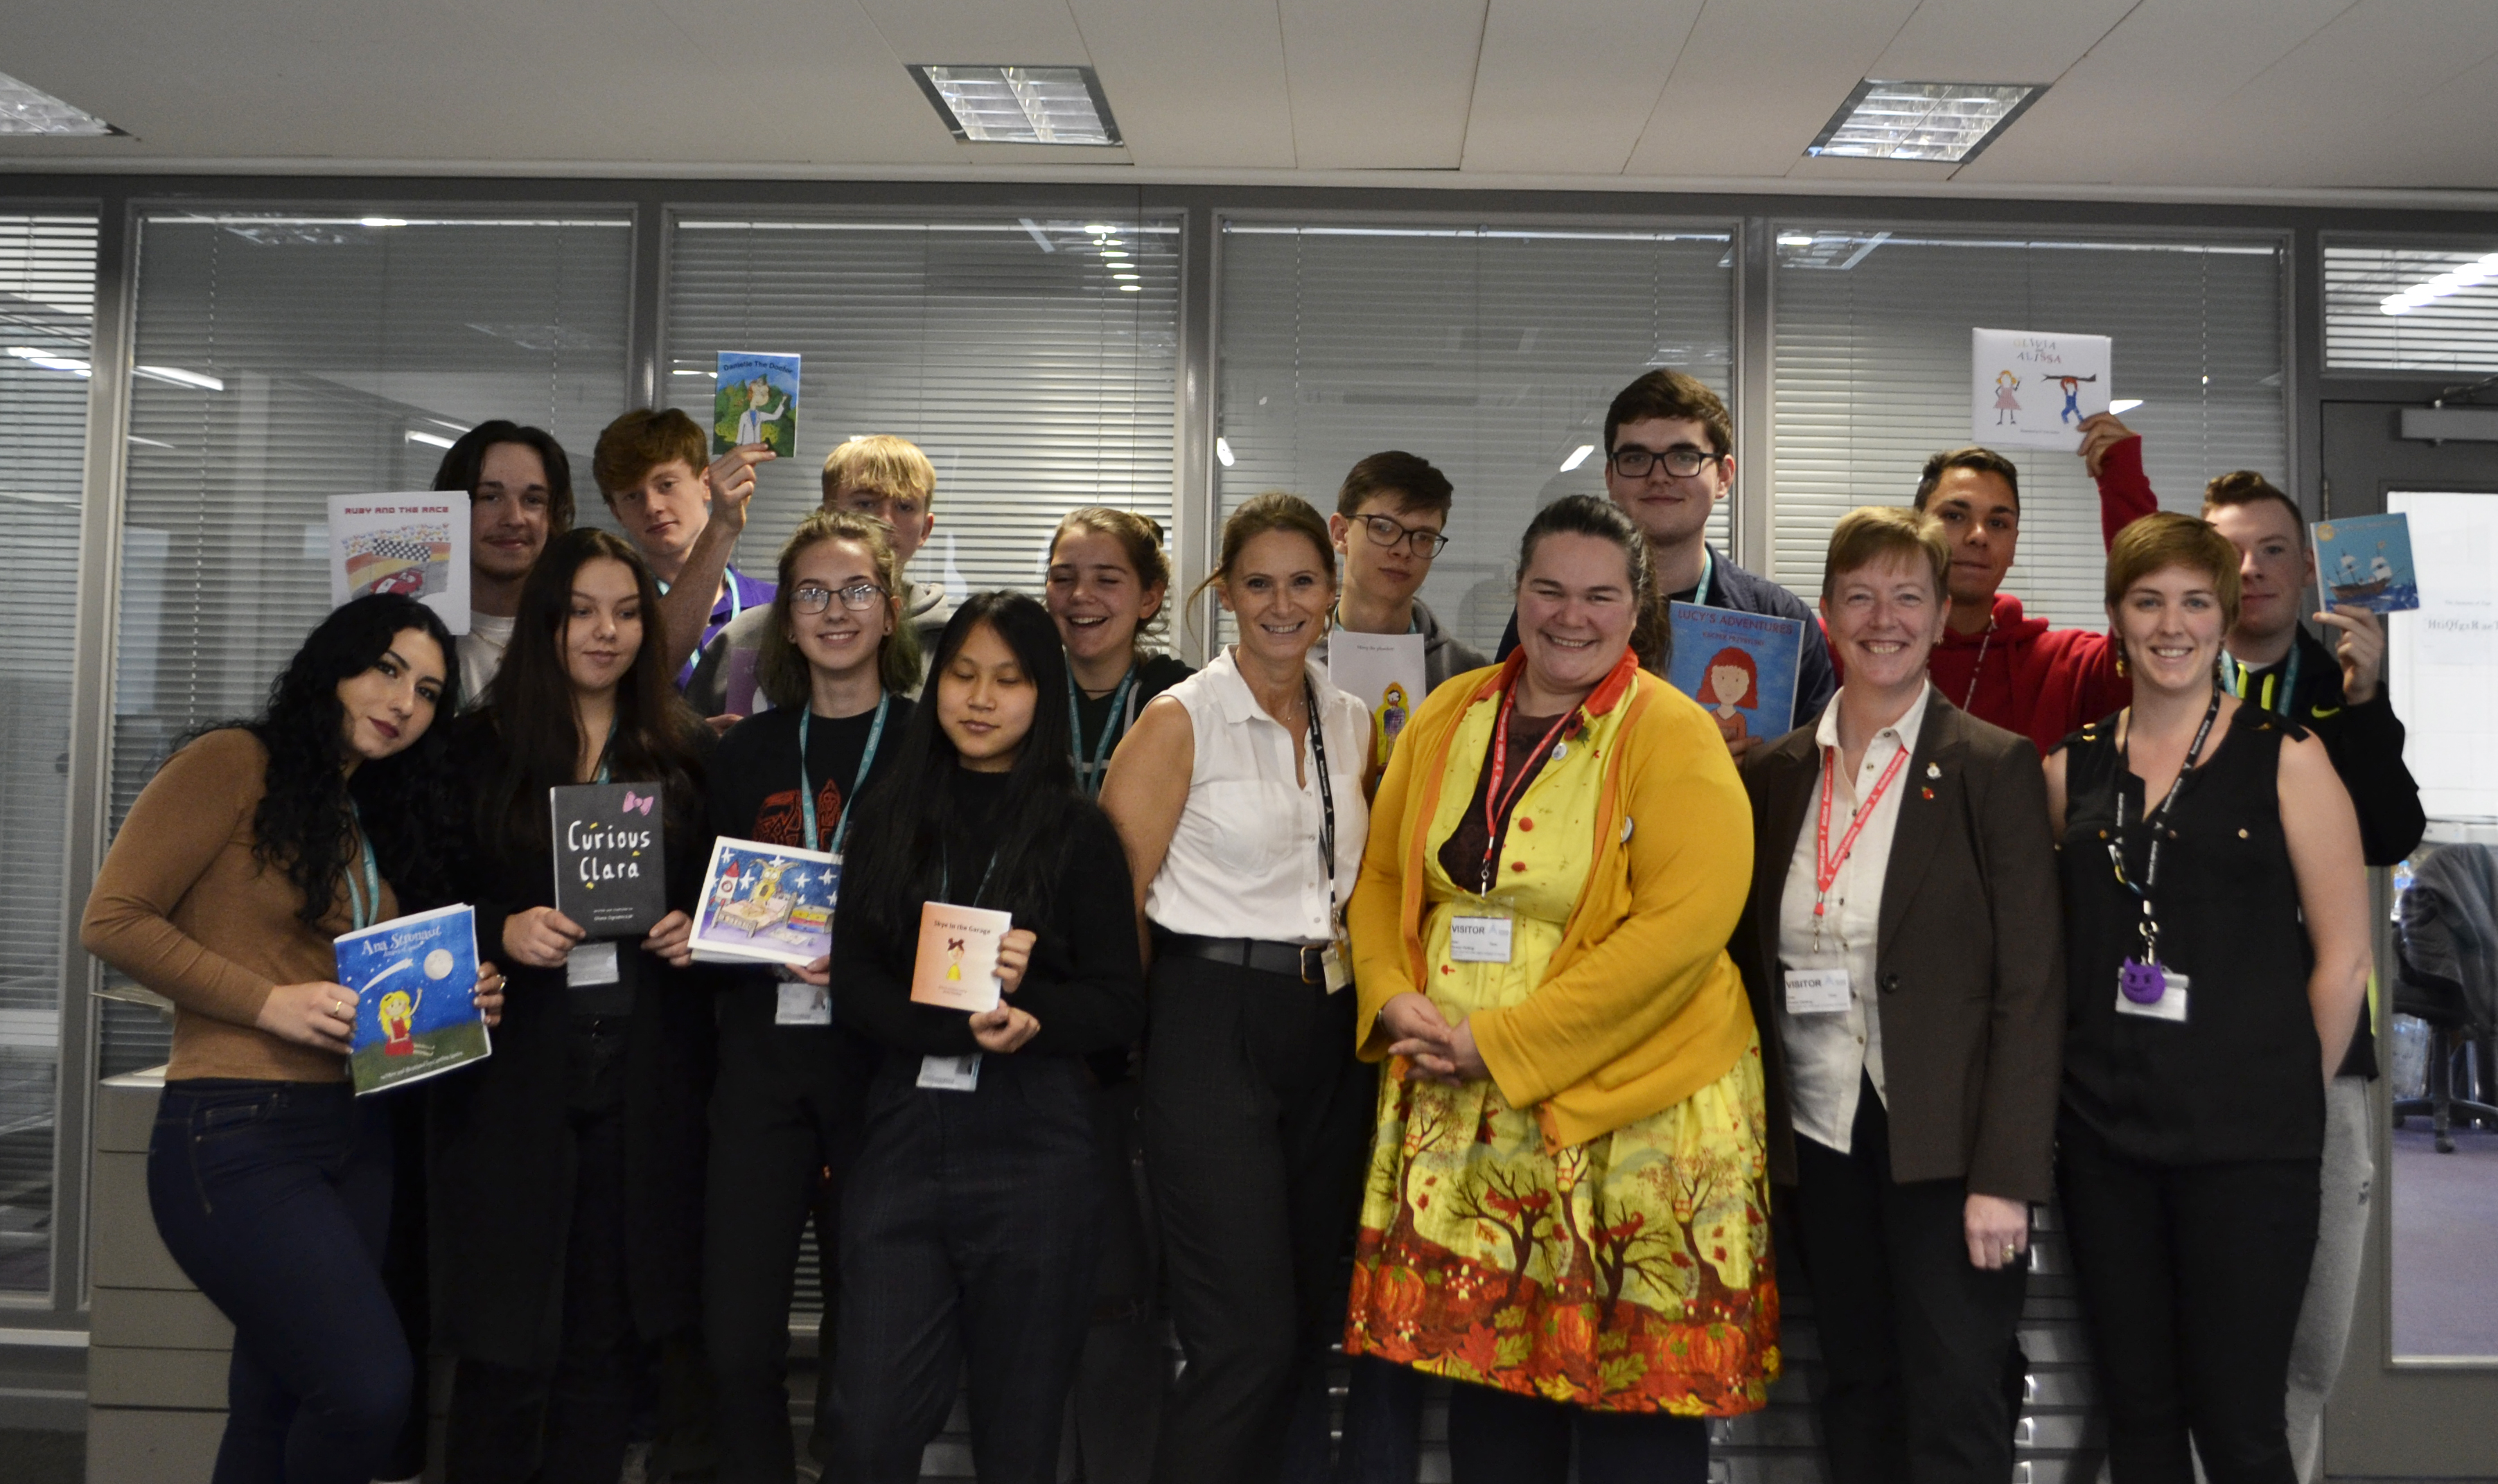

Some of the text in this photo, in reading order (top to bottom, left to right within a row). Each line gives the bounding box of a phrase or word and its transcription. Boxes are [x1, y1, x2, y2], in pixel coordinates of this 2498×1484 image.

[723, 361, 753, 371] Danielle
[769, 362, 793, 373] Doctor
[1678, 608, 1716, 624] LUCY'S
[1720, 615, 1793, 635] ADVENTURES
[568, 820, 651, 851] Curious
[580, 856, 640, 881] Clara
[362, 939, 388, 955] Ana
[390, 925, 442, 949] Stronaut
[1452, 925, 1485, 934] VISITOR
[1786, 979, 1822, 989] VISITOR
